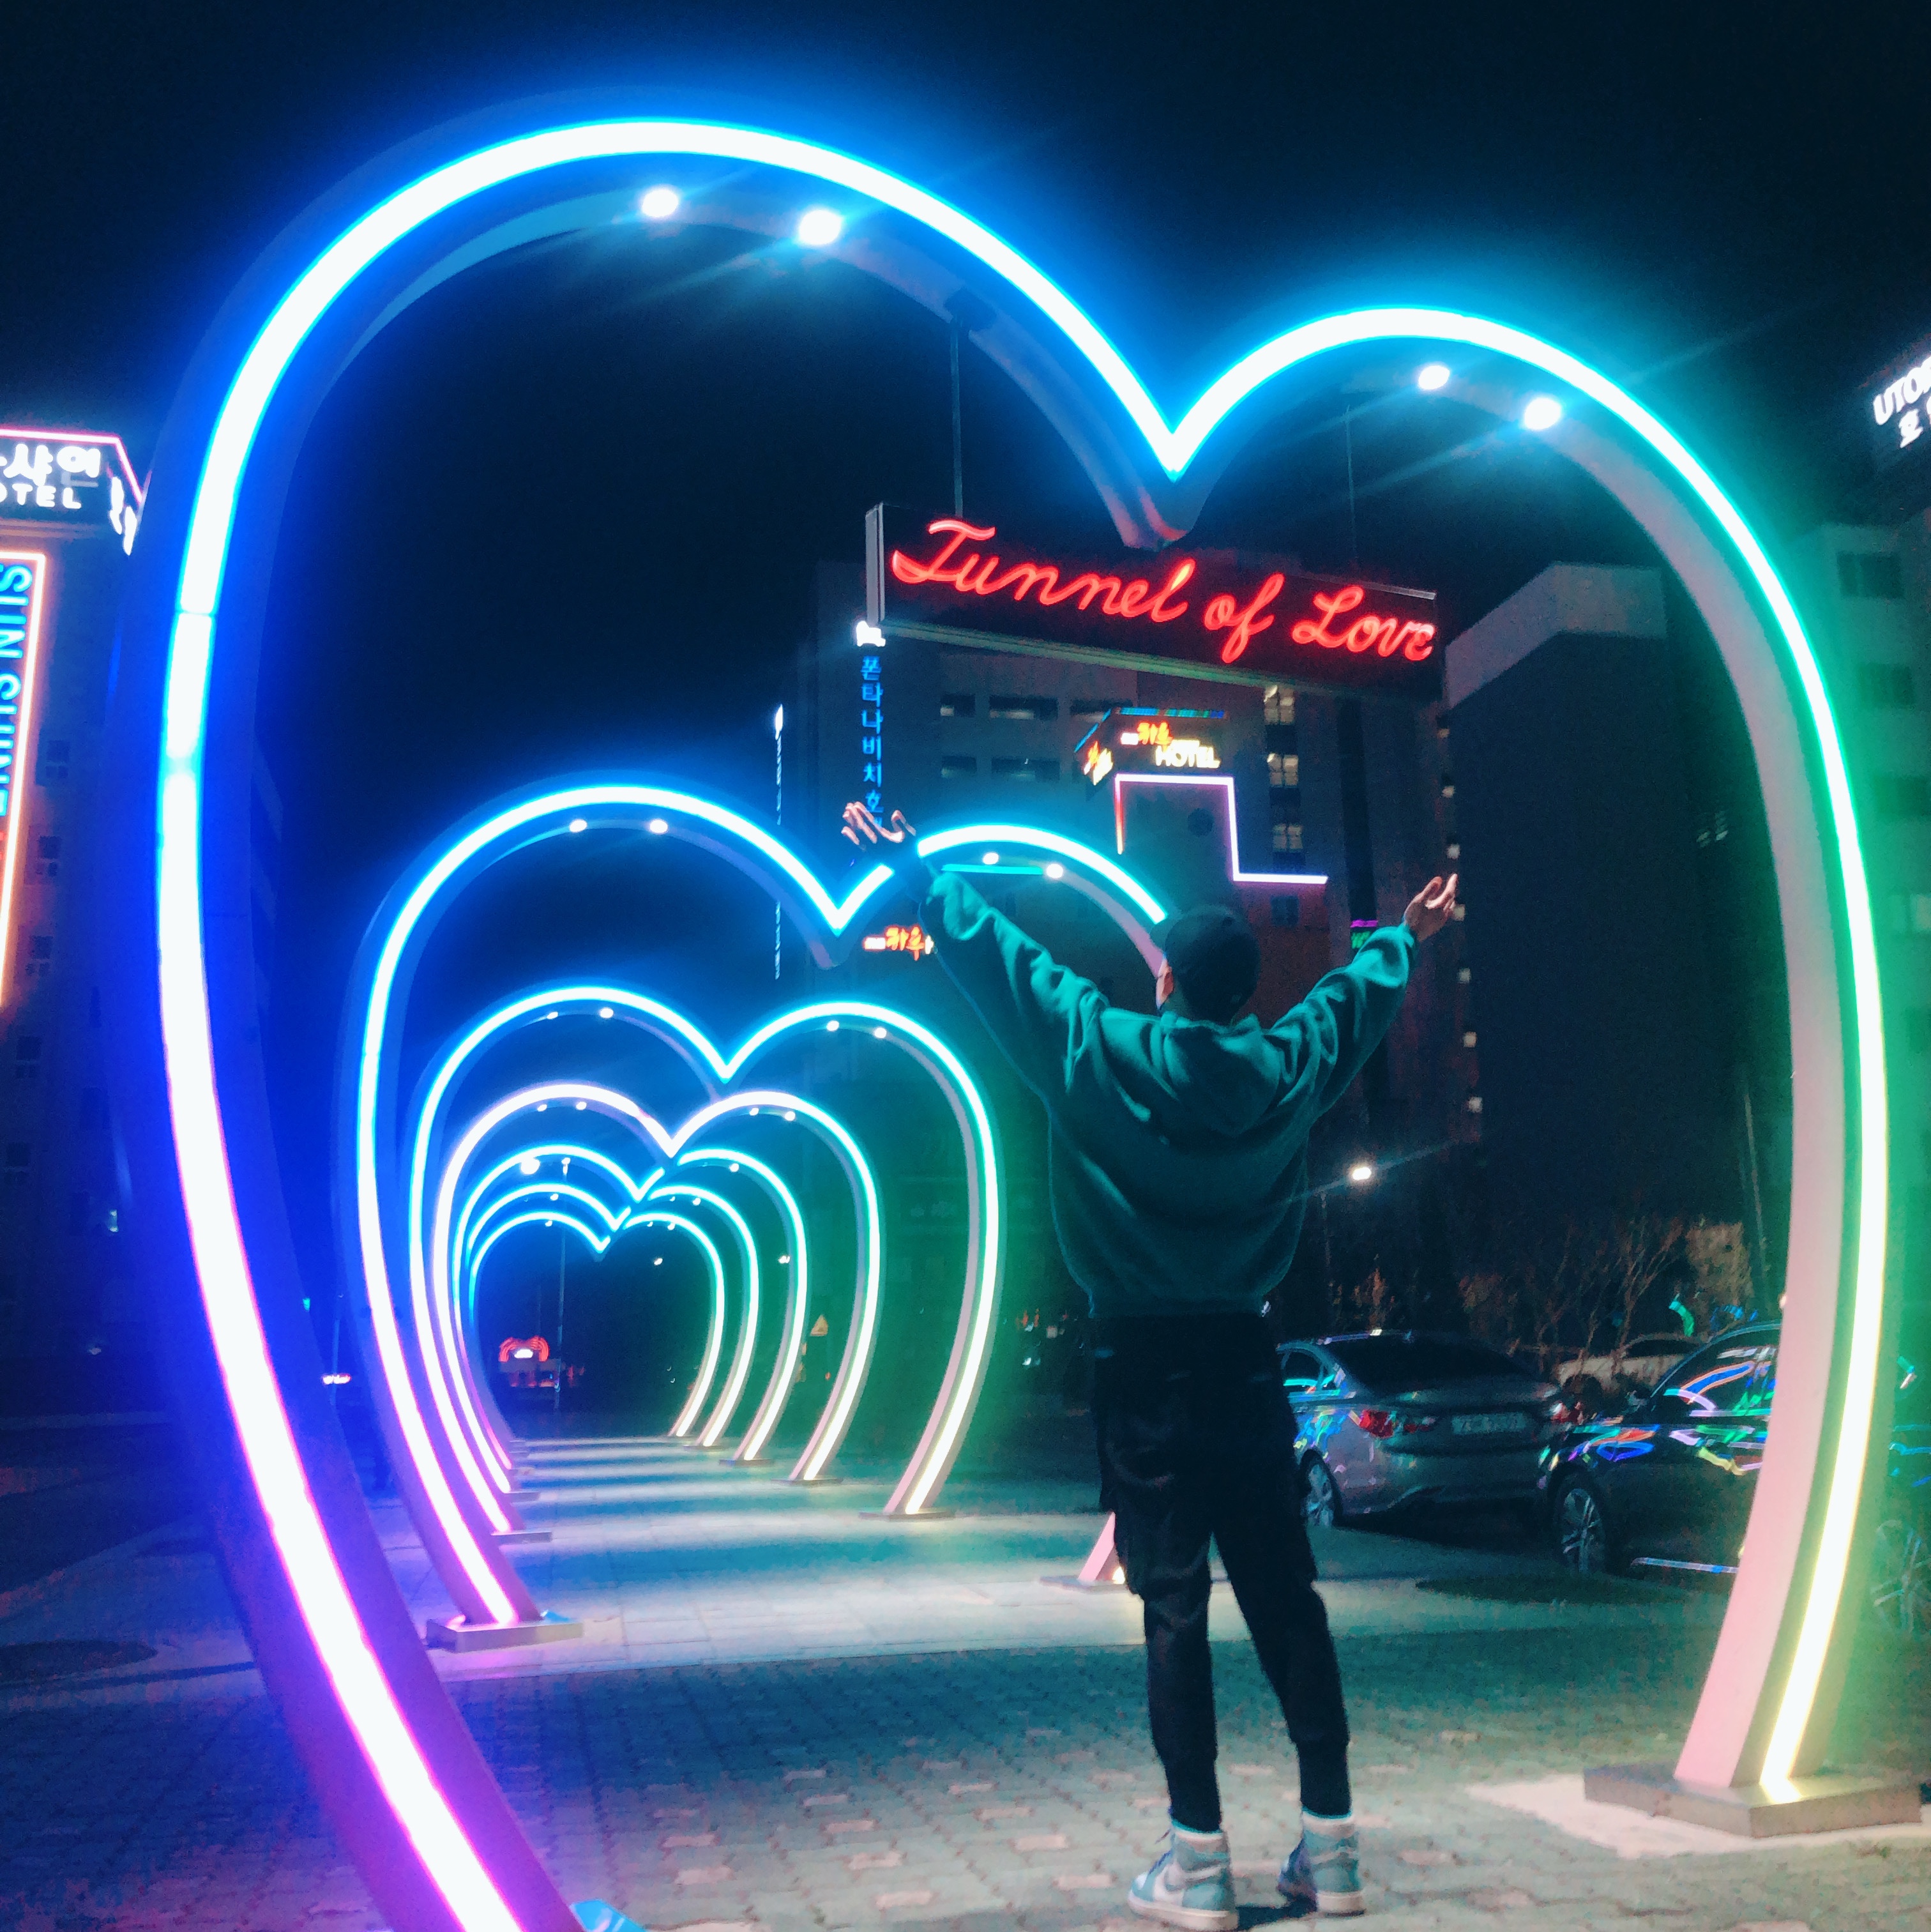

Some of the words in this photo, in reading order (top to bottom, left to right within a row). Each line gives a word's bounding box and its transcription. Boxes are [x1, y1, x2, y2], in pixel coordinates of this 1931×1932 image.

[891, 519, 1196, 623] Tunnel
[1203, 572, 1285, 664] of
[1291, 585, 1437, 662] Love
[861, 655, 884, 829] 폰타나비치호
[1155, 739, 1221, 769] HOTEL
